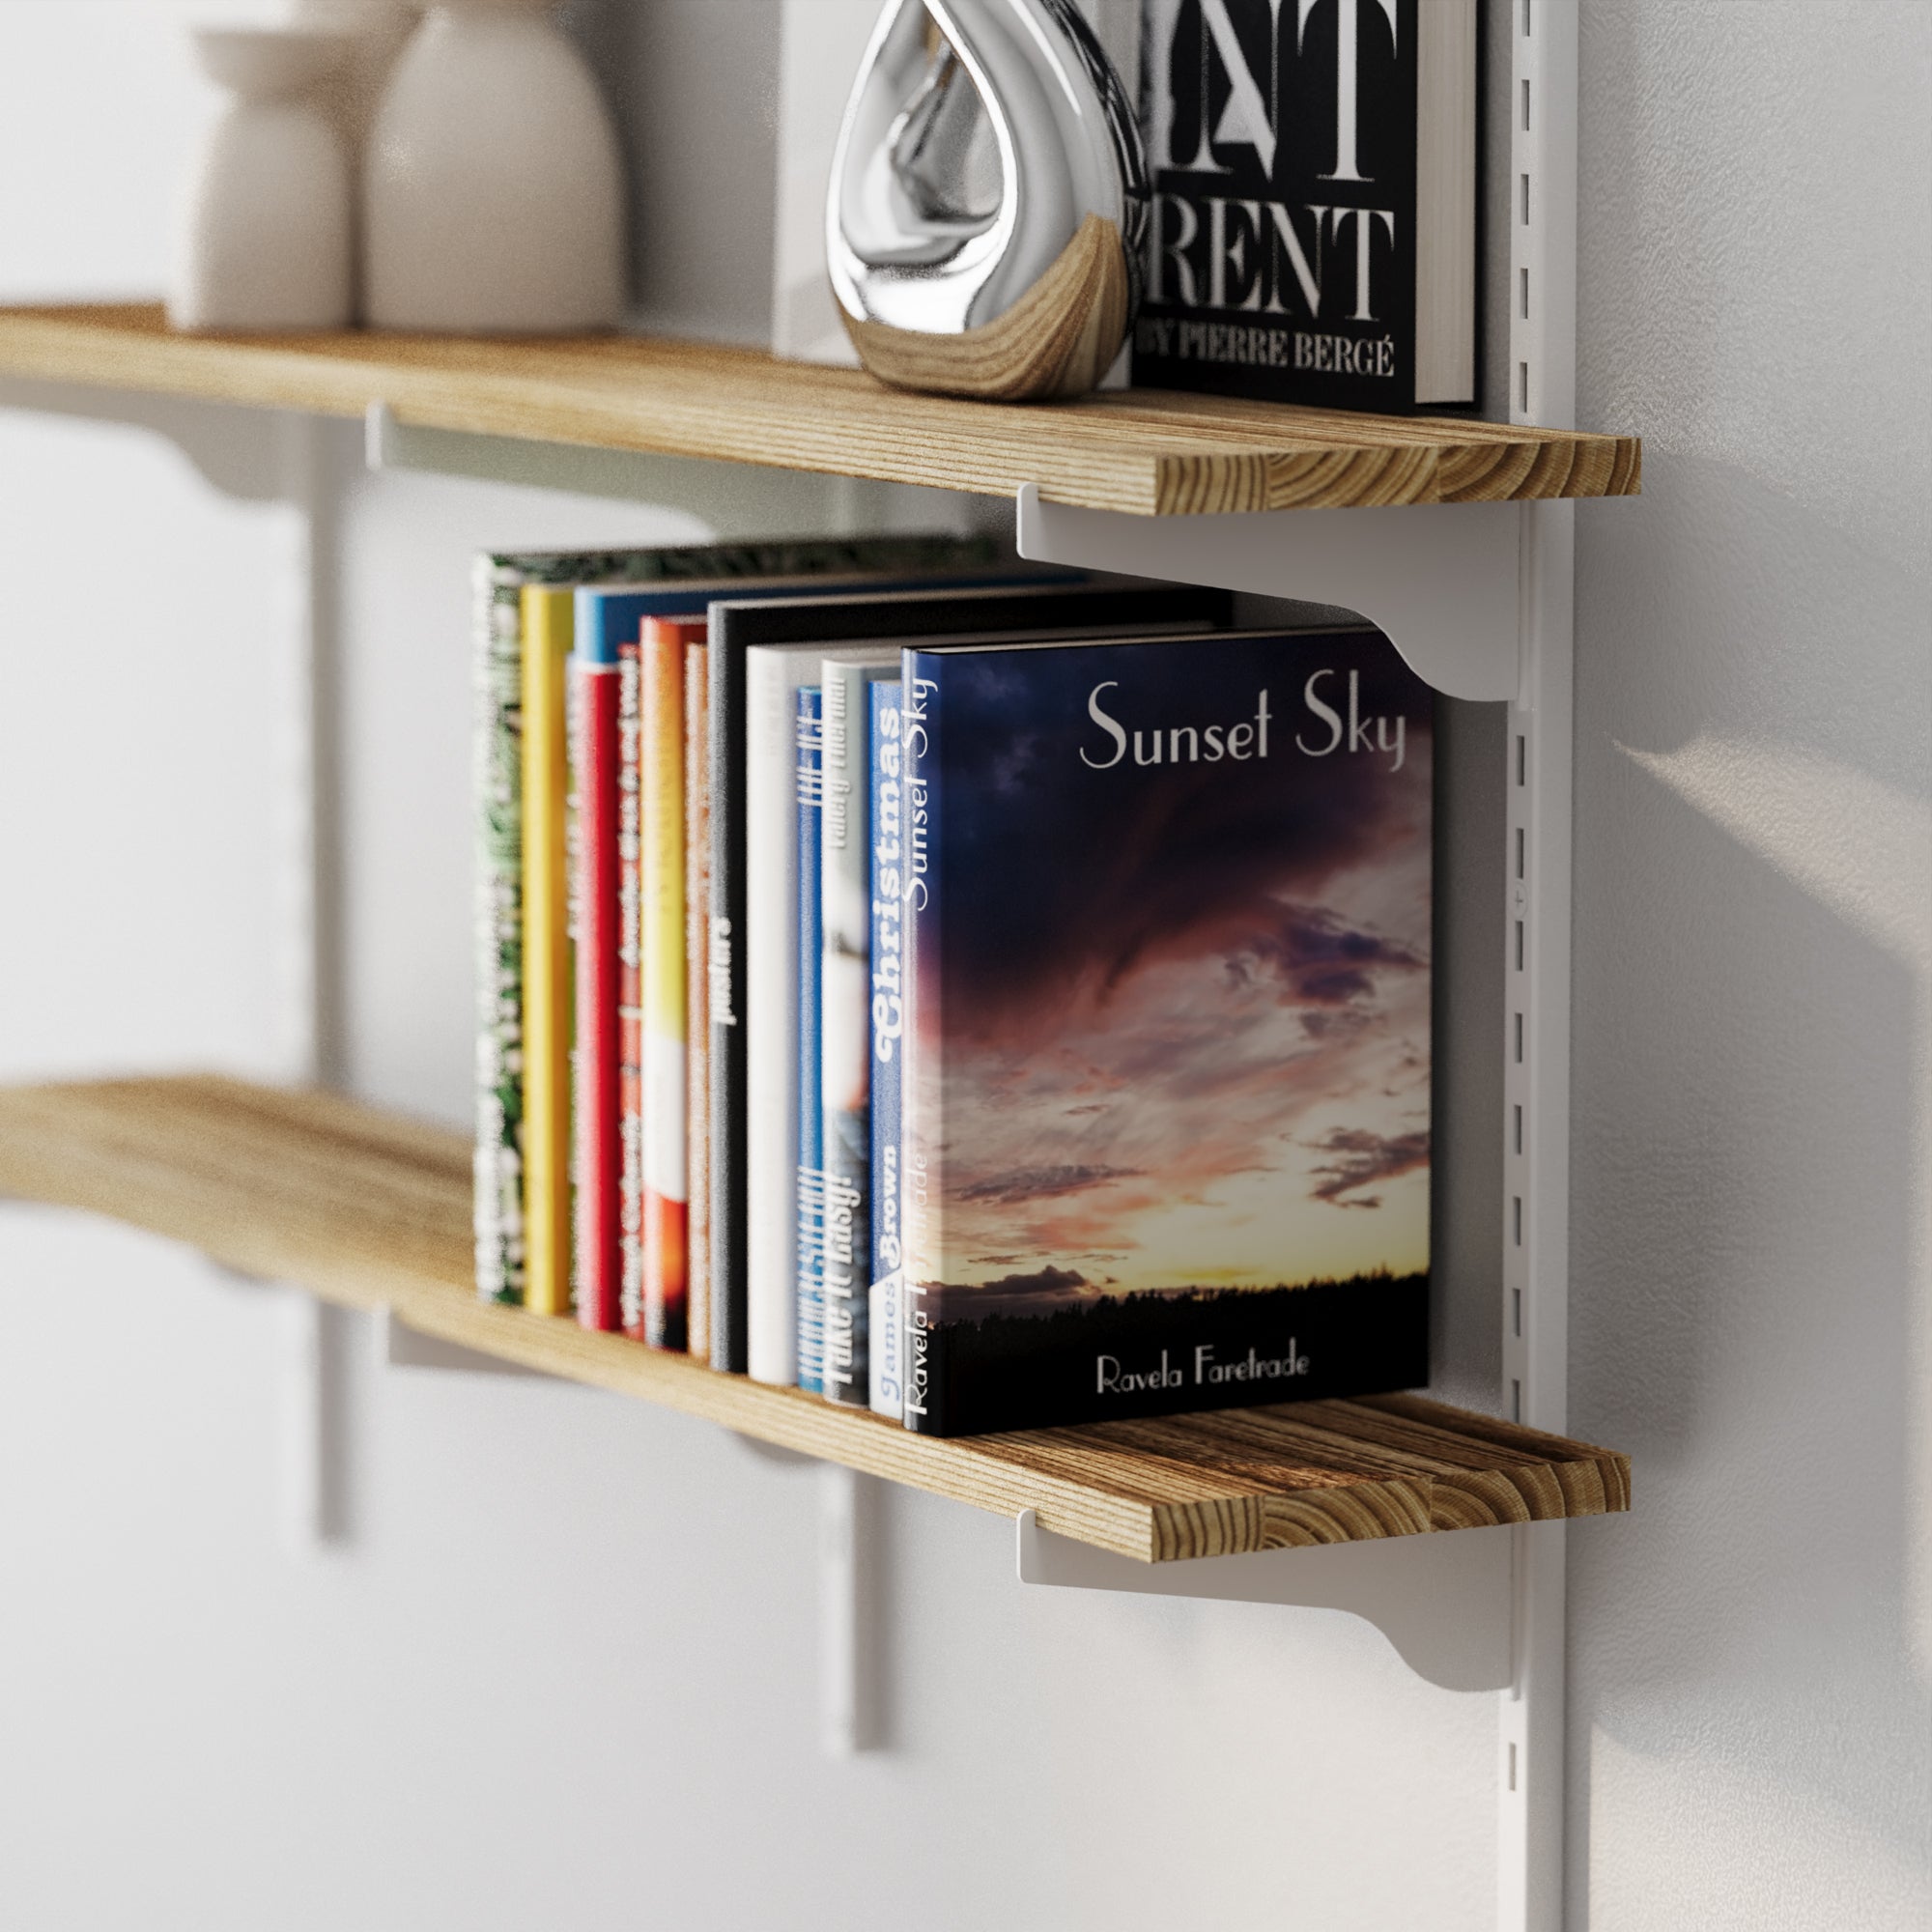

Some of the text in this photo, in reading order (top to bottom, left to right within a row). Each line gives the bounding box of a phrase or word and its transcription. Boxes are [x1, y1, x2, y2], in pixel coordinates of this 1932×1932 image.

[1145, 194, 1395, 322] RENT
[1179, 320, 1288, 368] PIERRE
[1294, 333, 1395, 377] BERGÉ
[826, 677, 847, 769] Thermal
[1079, 668, 1406, 773] Sunset Sky
[901, 678, 938, 911] Sunset Sky
[872, 707, 902, 1063] Christmas
[823, 1171, 862, 1264] Easy!
[880, 1145, 900, 1401] James Brown
[823, 1307, 852, 1385] Take
[904, 1311, 928, 1415] Ravela
[1096, 1337, 1311, 1393] Ravela Faretrade
